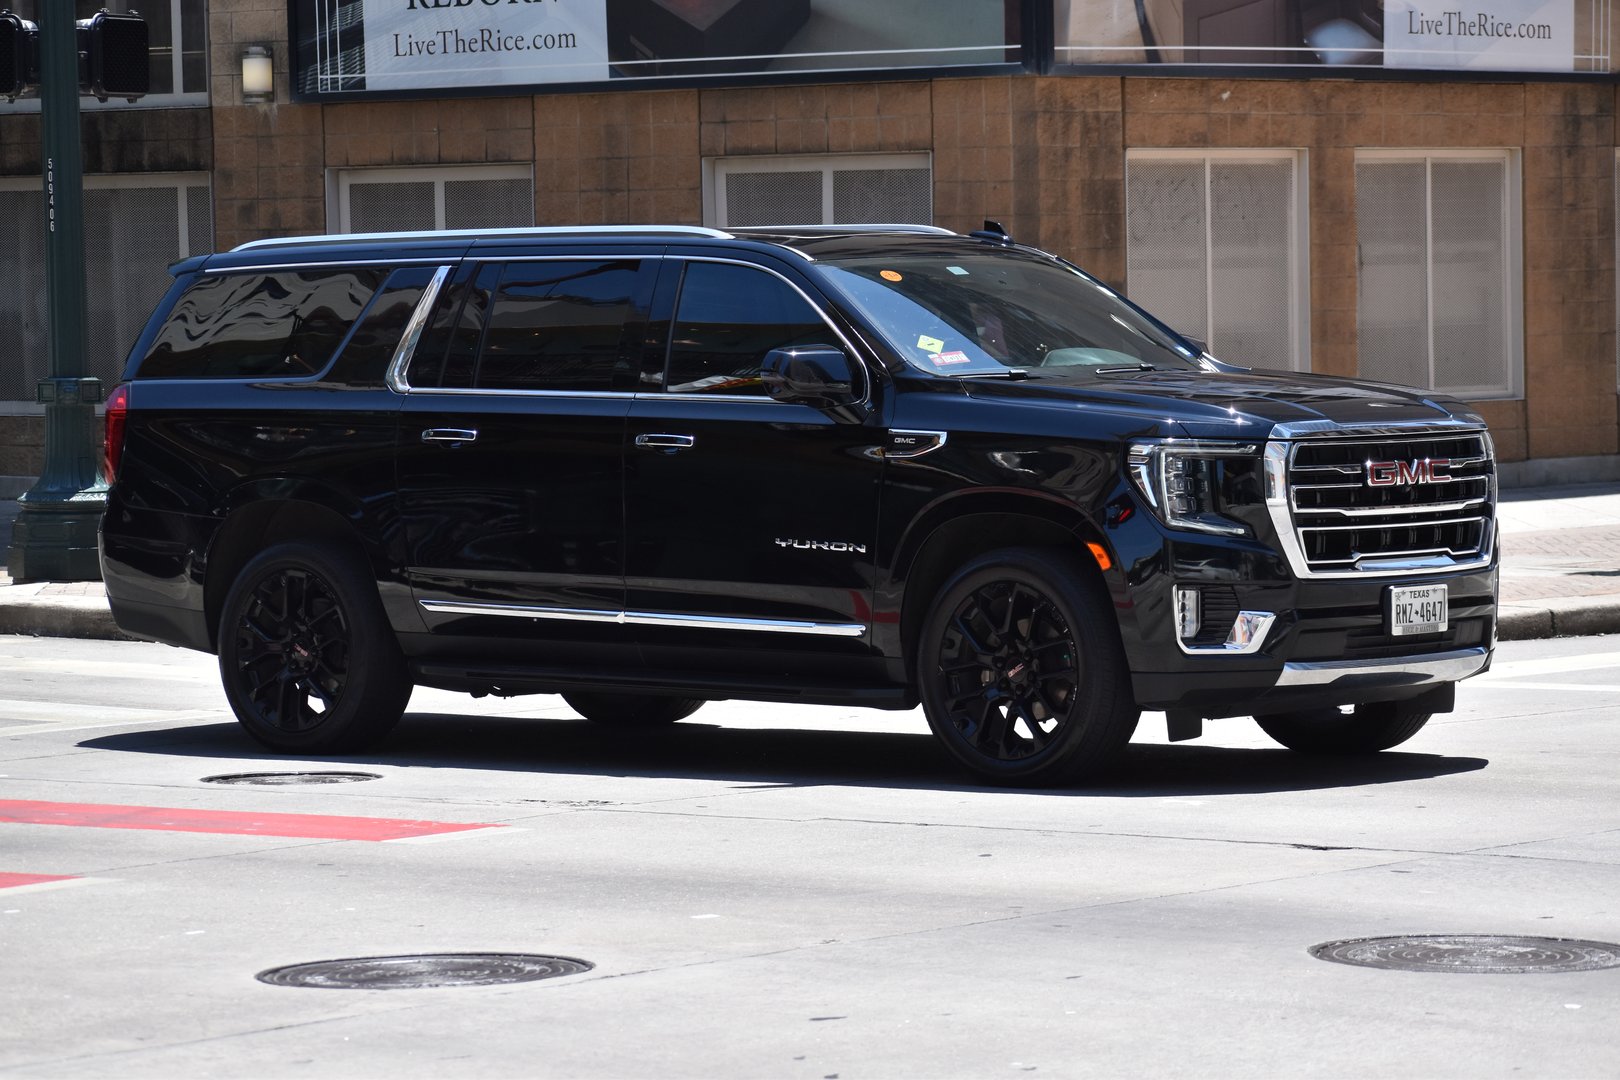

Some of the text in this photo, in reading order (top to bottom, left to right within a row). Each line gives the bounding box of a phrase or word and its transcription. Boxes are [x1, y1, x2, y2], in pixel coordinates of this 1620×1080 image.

[1407, 11, 1552, 39] LiveTheRice.com
[393, 28, 577, 57] LiveTheRice.com
[47, 158, 55, 232] 509406
[1366, 458, 1452, 487] GMC
[775, 538, 866, 553] YUKON
[1409, 590, 1430, 599] TEXAS
